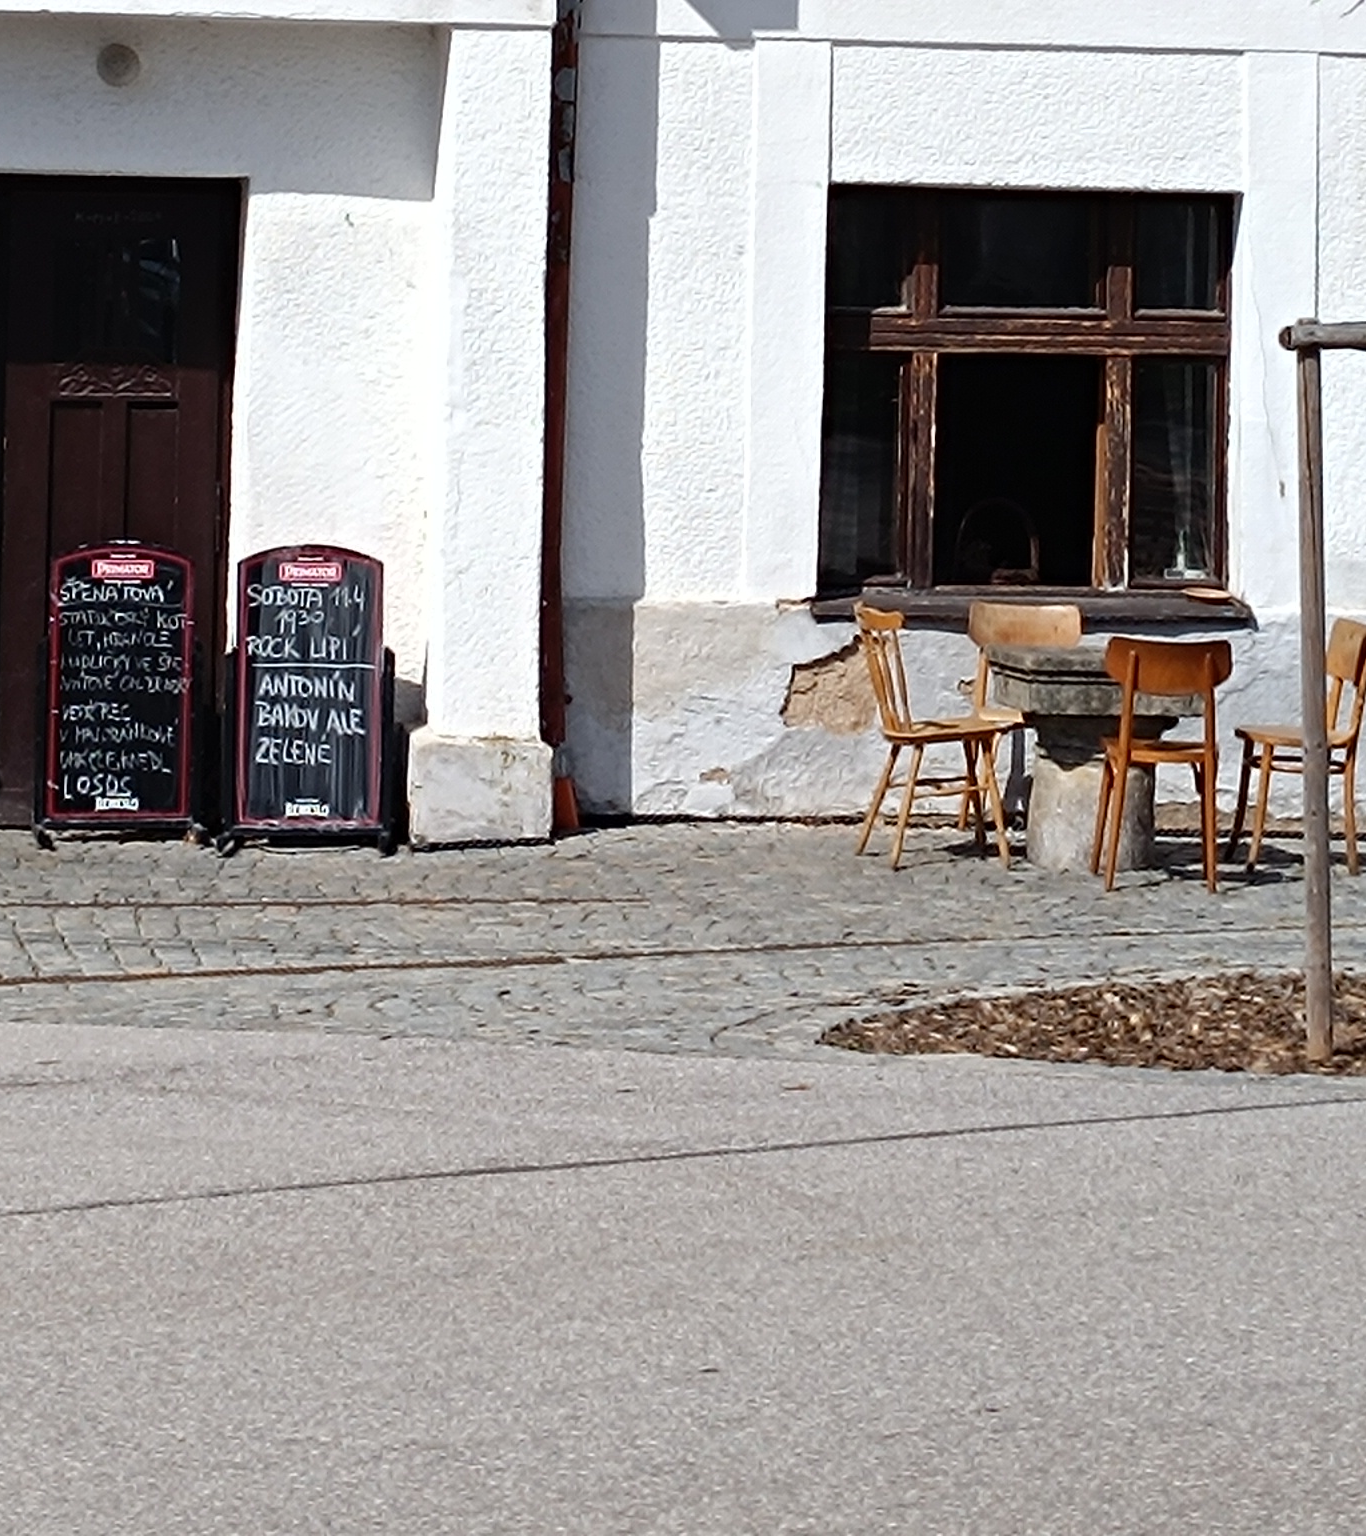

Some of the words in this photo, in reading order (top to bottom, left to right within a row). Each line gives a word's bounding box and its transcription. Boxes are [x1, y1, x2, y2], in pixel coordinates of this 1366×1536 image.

[247, 583, 323, 608] SOBOTA
[245, 635, 300, 659] ROCK
[259, 670, 355, 702] ANTONÍN
